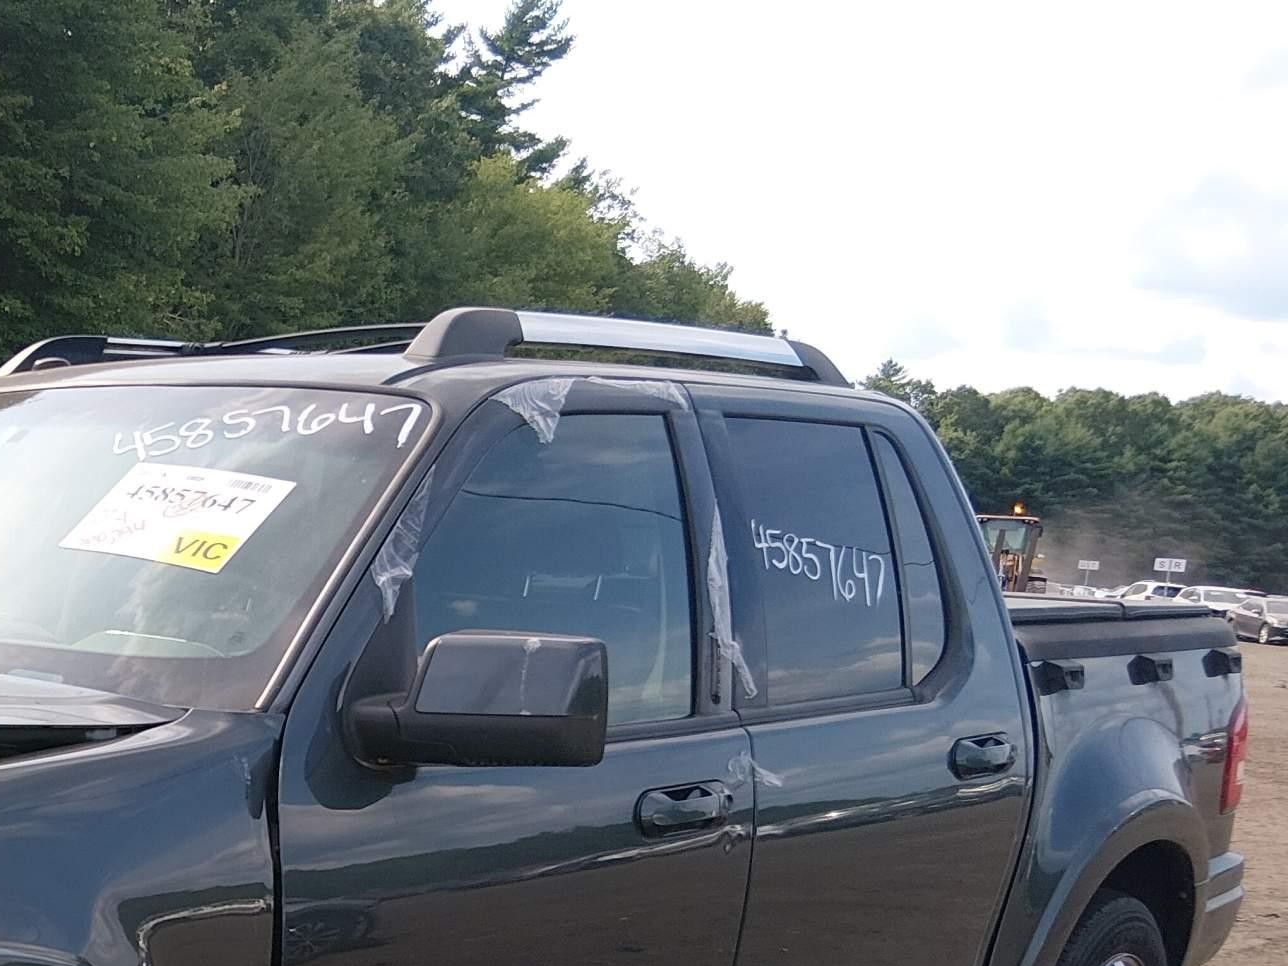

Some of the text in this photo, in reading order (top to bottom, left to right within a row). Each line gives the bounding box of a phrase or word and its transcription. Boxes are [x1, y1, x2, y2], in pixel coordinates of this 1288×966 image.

[113, 402, 422, 461] 45857647
[127, 484, 257, 514] 45857647
[173, 536, 229, 561] VIC
[750, 518, 885, 607] 45857647
